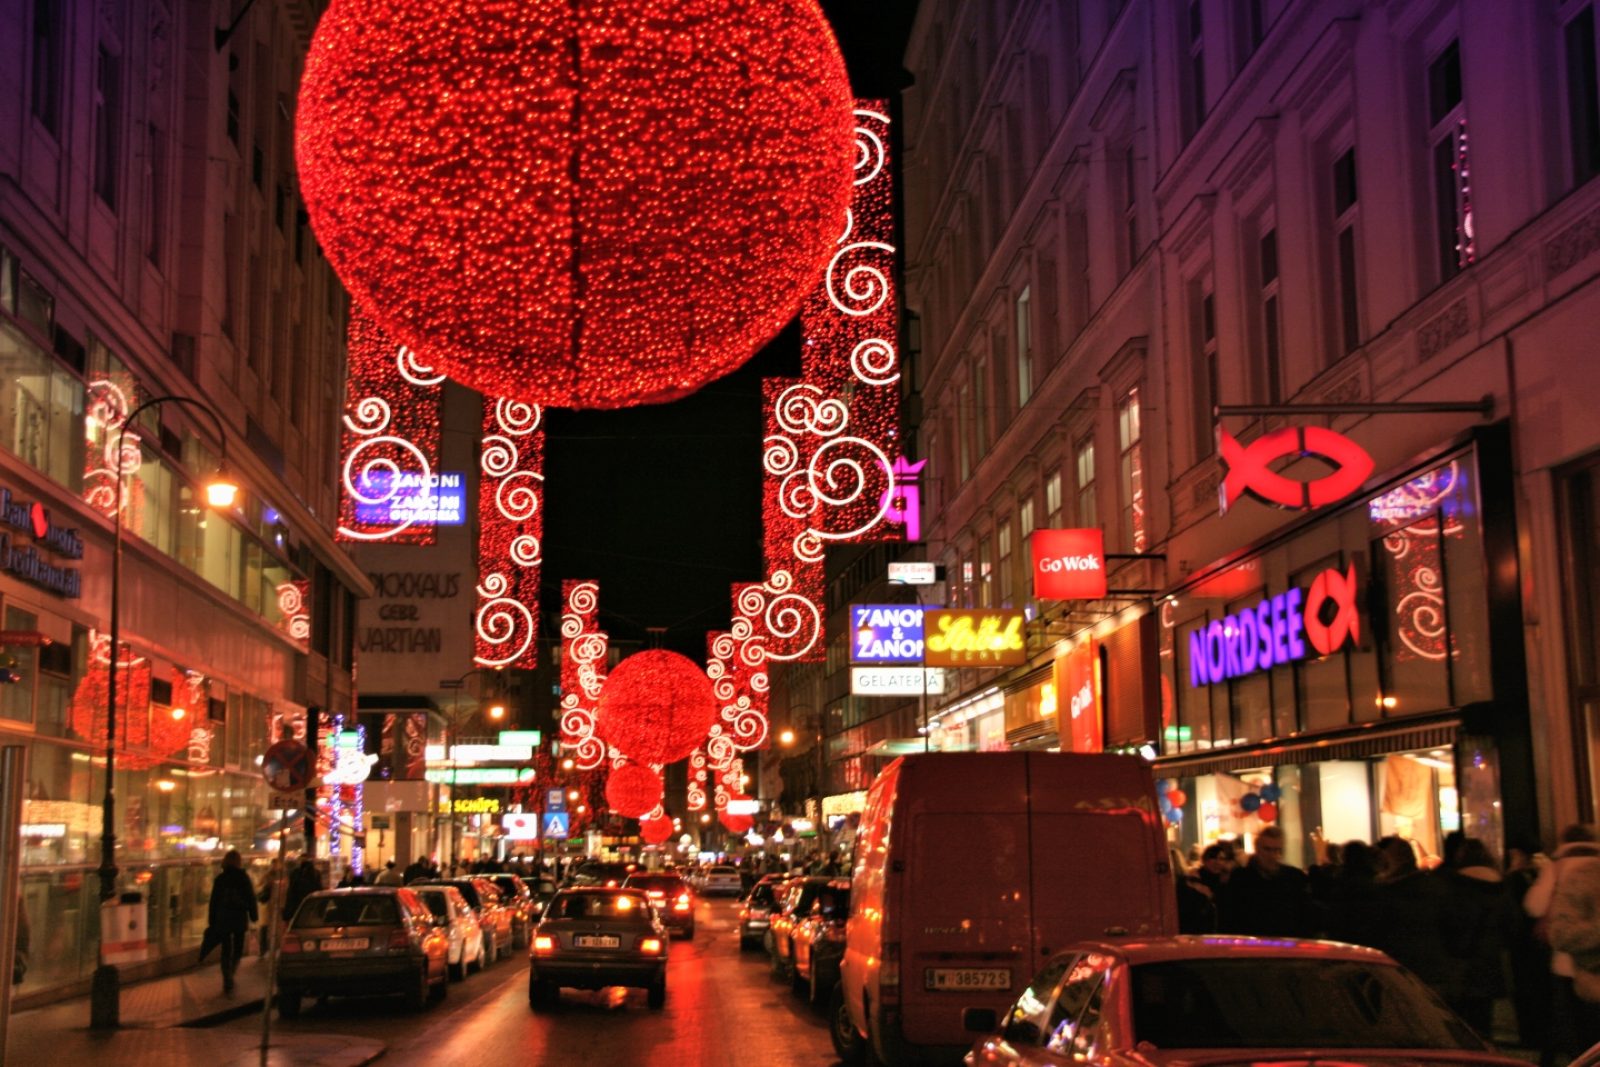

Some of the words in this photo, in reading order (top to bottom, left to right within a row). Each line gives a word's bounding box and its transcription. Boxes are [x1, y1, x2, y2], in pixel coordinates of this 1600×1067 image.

[1039, 557, 1062, 572] Go
[1063, 555, 1100, 570] Wok
[891, 627, 904, 640] &
[1189, 587, 1304, 688] NORDSEE
